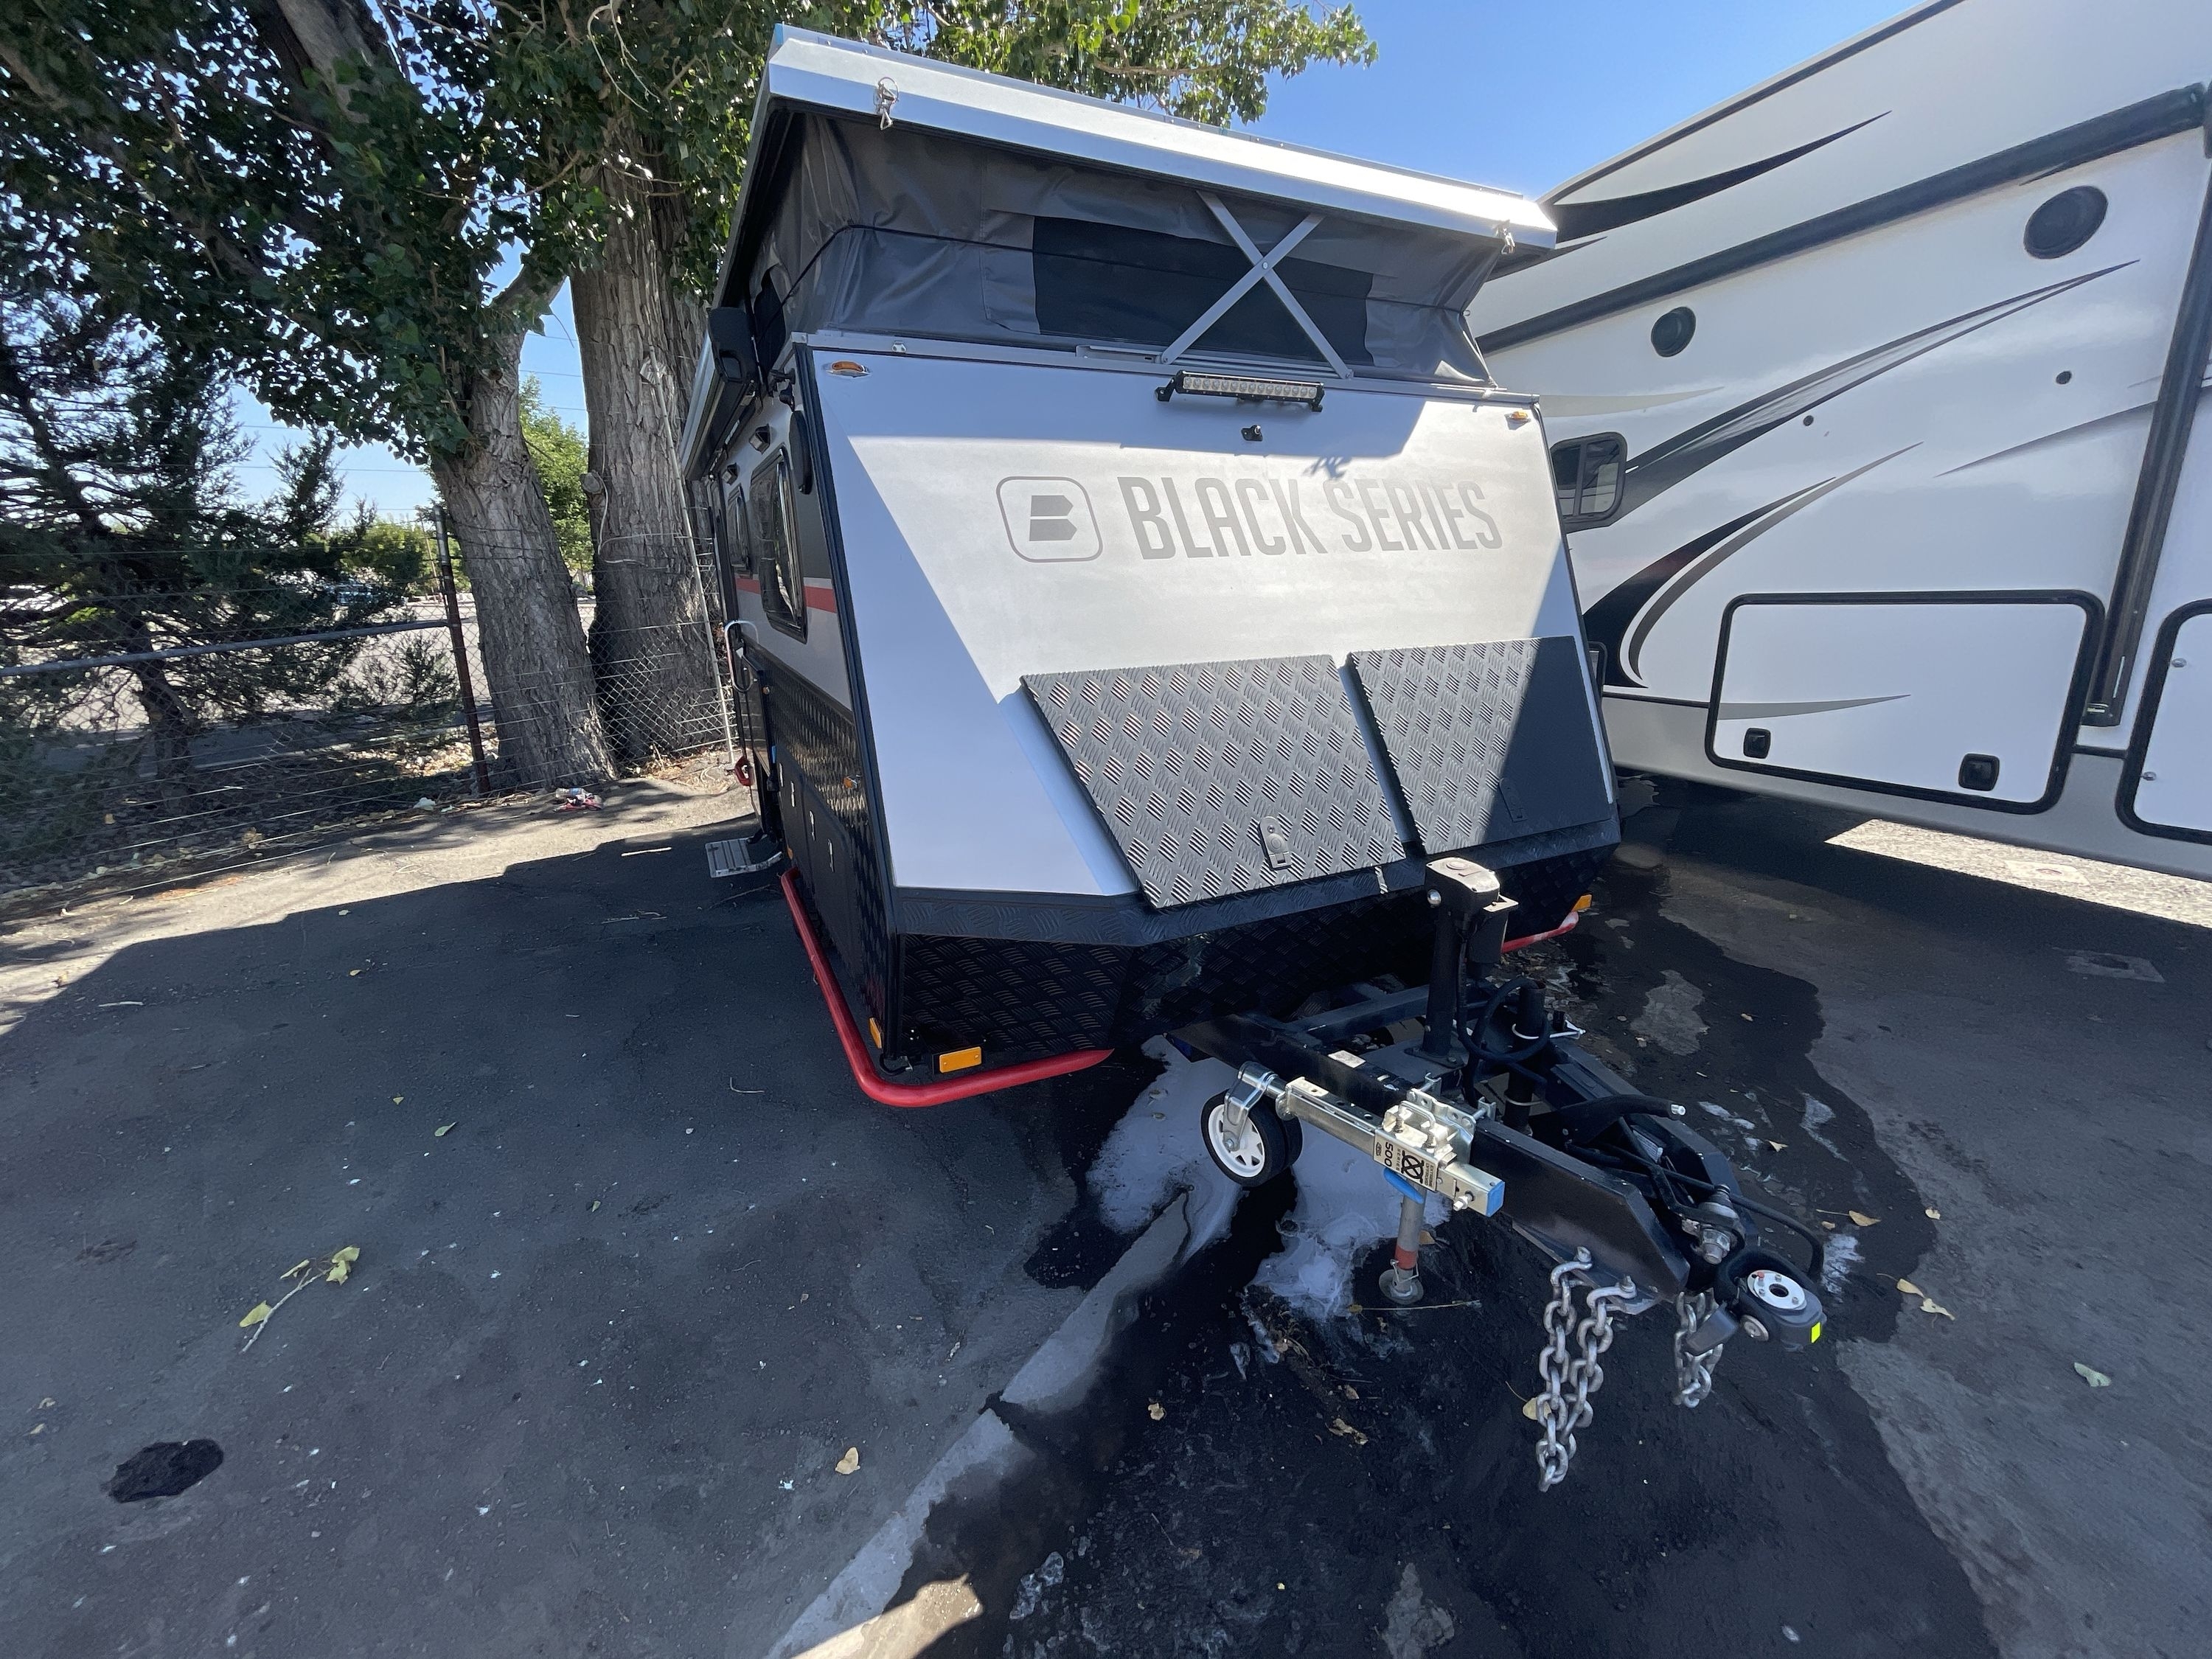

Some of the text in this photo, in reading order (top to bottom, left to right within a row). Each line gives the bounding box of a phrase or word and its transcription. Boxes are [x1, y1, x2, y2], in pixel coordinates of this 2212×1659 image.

[1117, 476, 1503, 560] BLACK SERIES
[1385, 1142, 1393, 1166] 500
